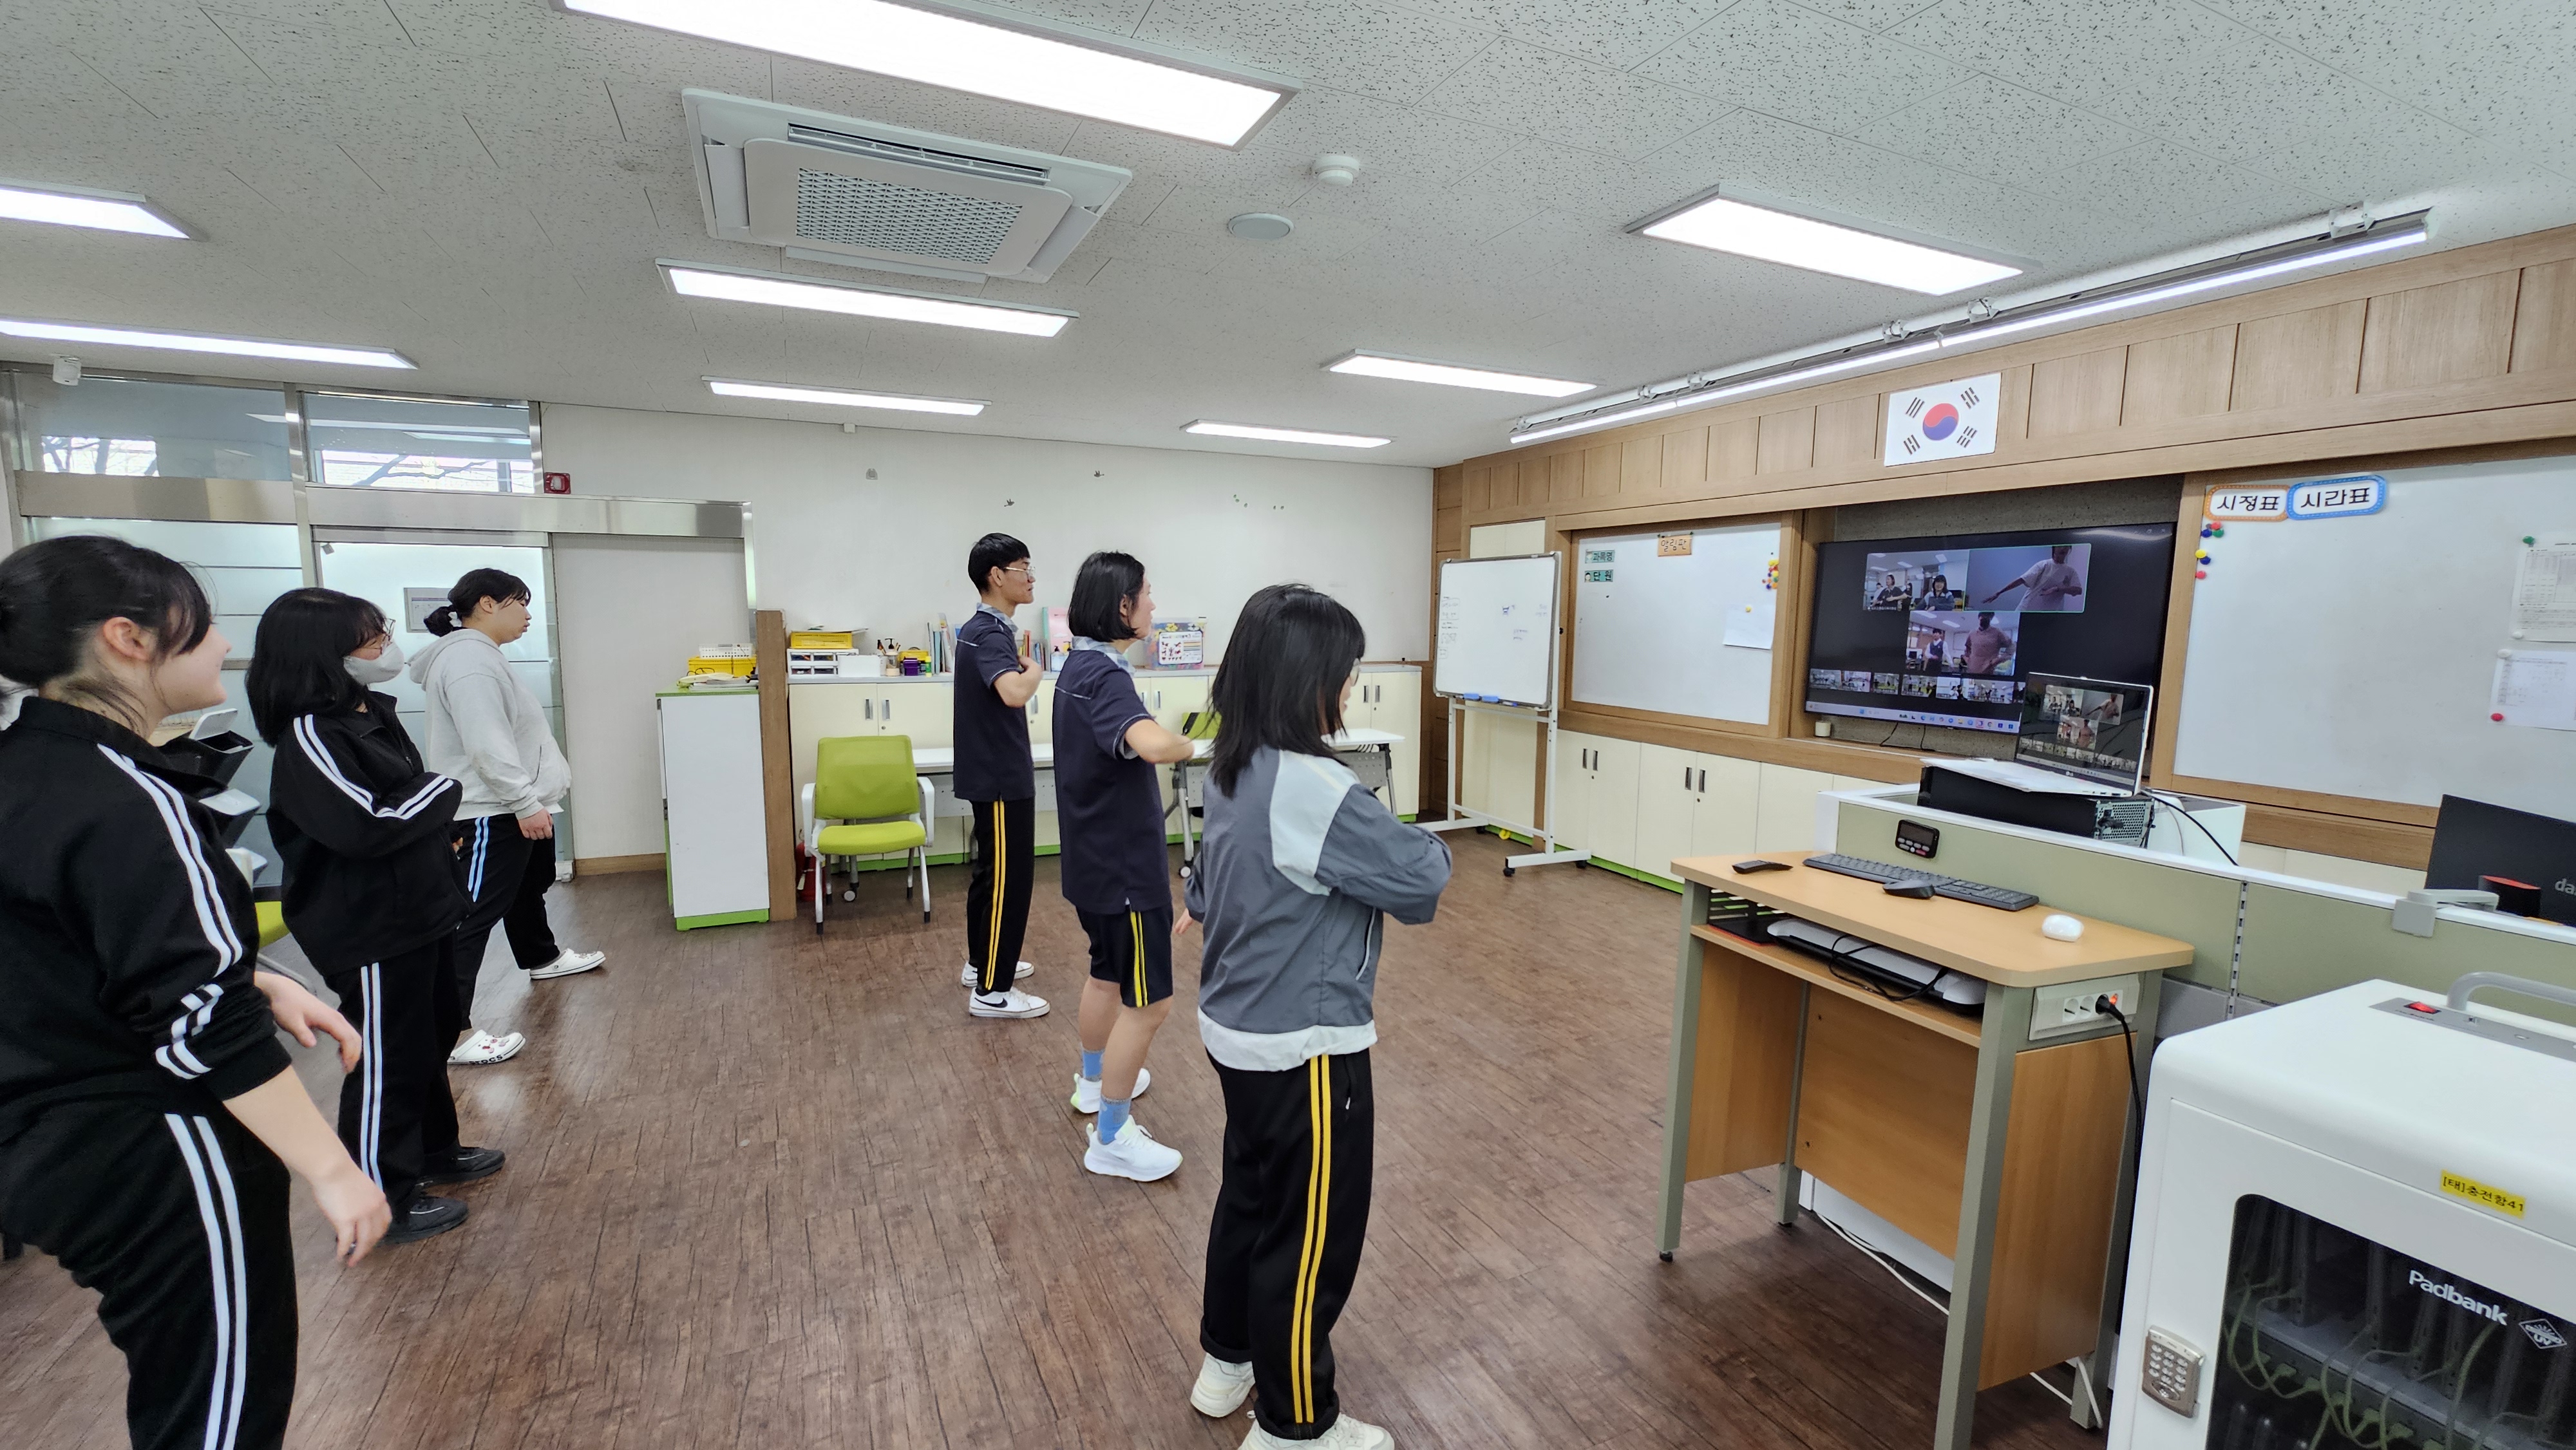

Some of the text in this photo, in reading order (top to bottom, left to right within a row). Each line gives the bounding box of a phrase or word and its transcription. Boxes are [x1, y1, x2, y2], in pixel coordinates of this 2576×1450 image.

[2217, 495, 2280, 511] 시정표
[2300, 487, 2371, 508] 시간표
[1661, 539, 1687, 552] 알림판
[2555, 878, 2576, 896] da
[2409, 1270, 2508, 1326] Padbank
